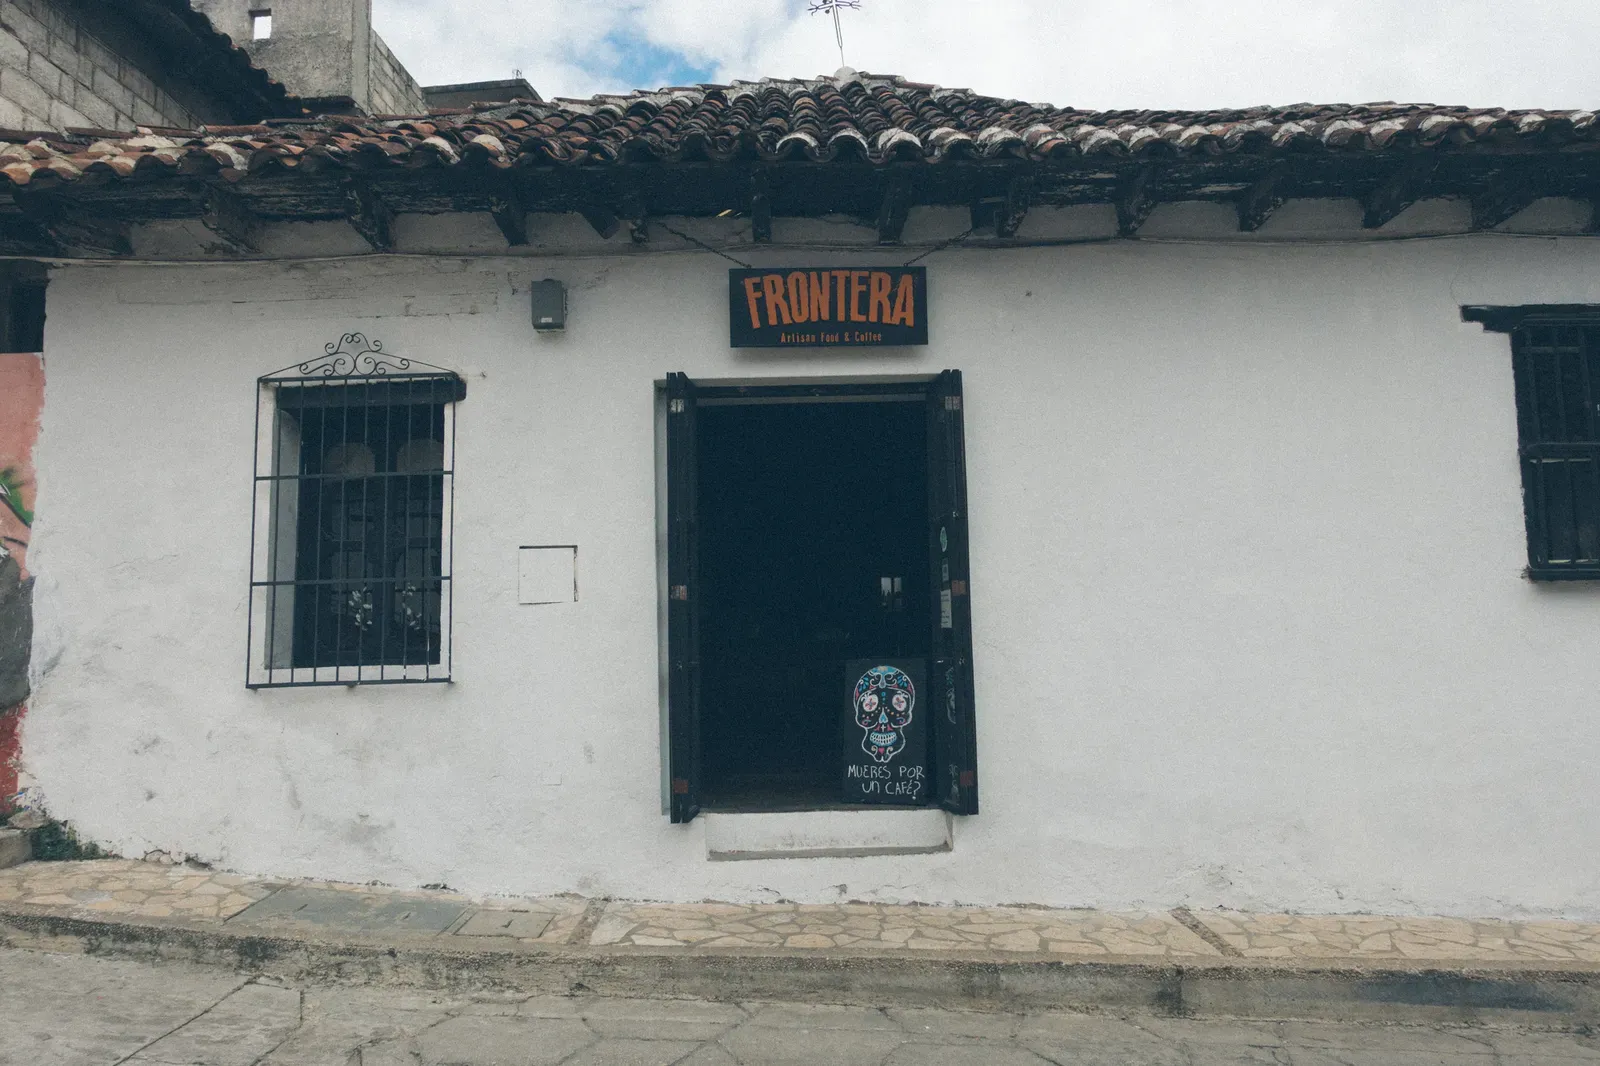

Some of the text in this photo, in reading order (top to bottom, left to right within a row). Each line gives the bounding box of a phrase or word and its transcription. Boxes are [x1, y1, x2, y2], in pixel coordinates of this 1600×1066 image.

[744, 270, 914, 329] FRONTERA
[781, 331, 882, 343] Artisan Food & Coffee
[847, 764, 925, 780] MUERES POR
